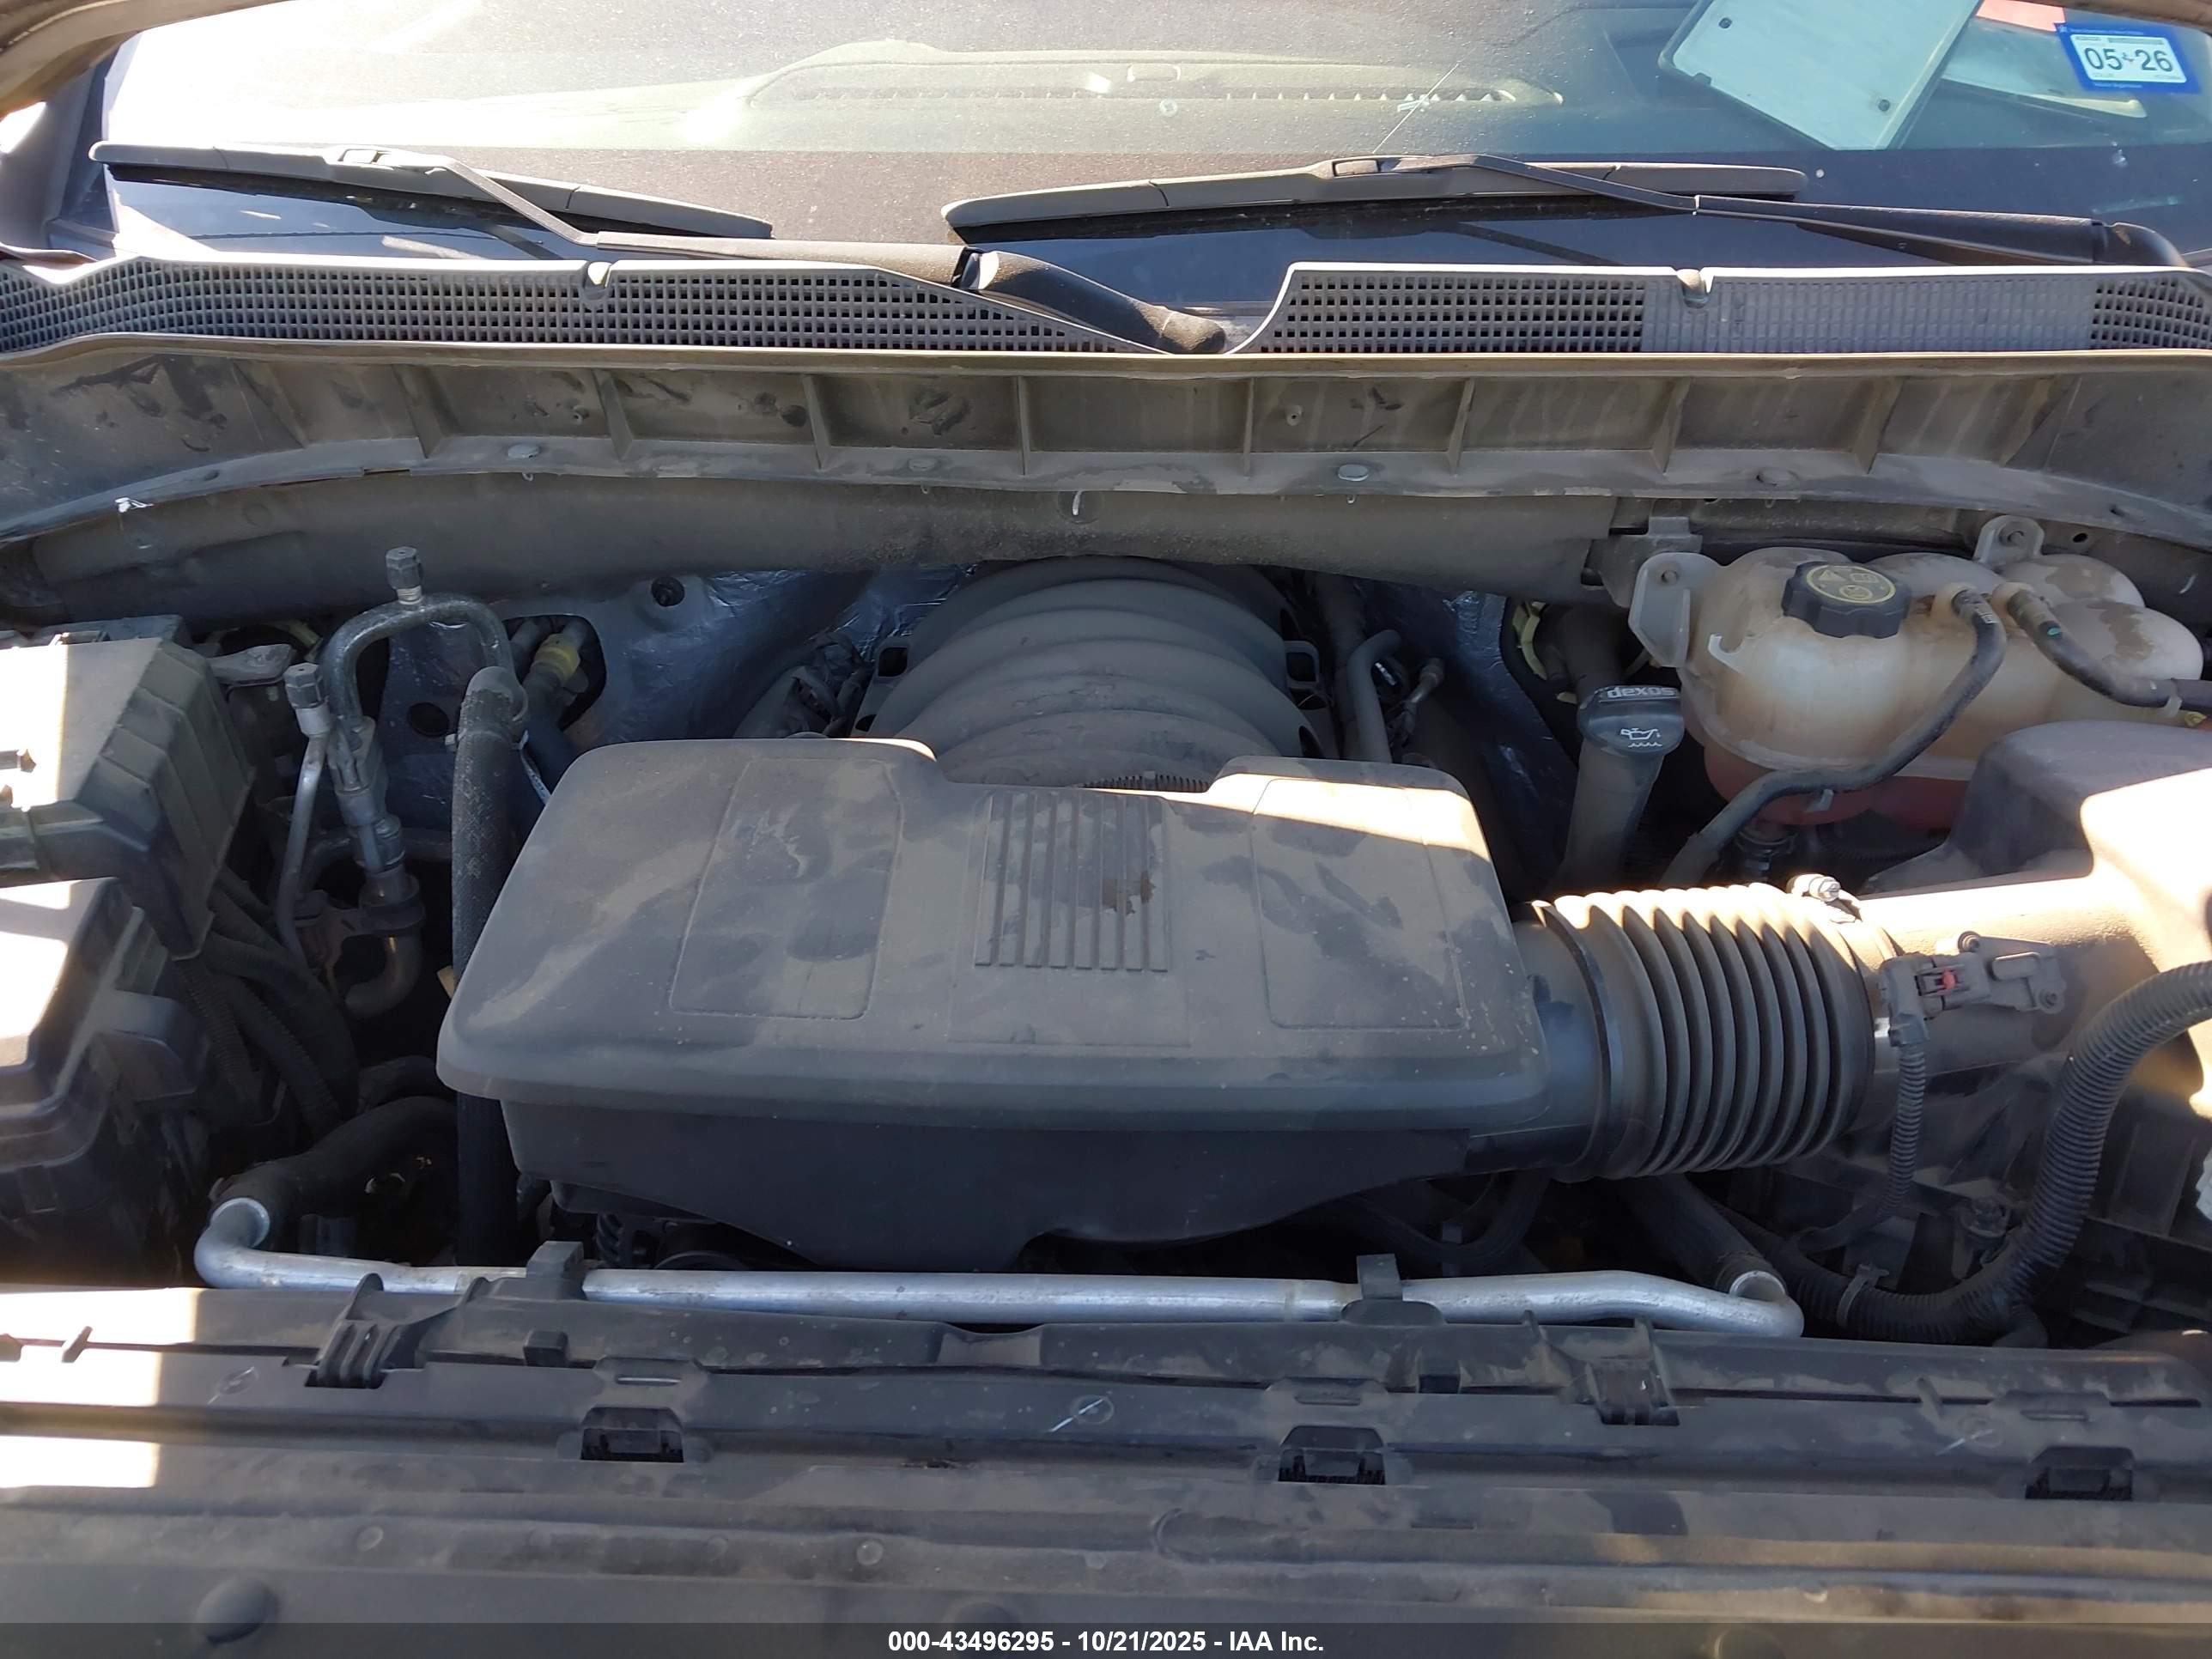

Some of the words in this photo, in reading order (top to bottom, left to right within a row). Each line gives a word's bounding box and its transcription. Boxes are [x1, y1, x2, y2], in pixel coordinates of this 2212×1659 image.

[2084, 47, 2123, 70] 05
[2135, 49, 2173, 72] 26
[1606, 686, 1675, 698] dexos
